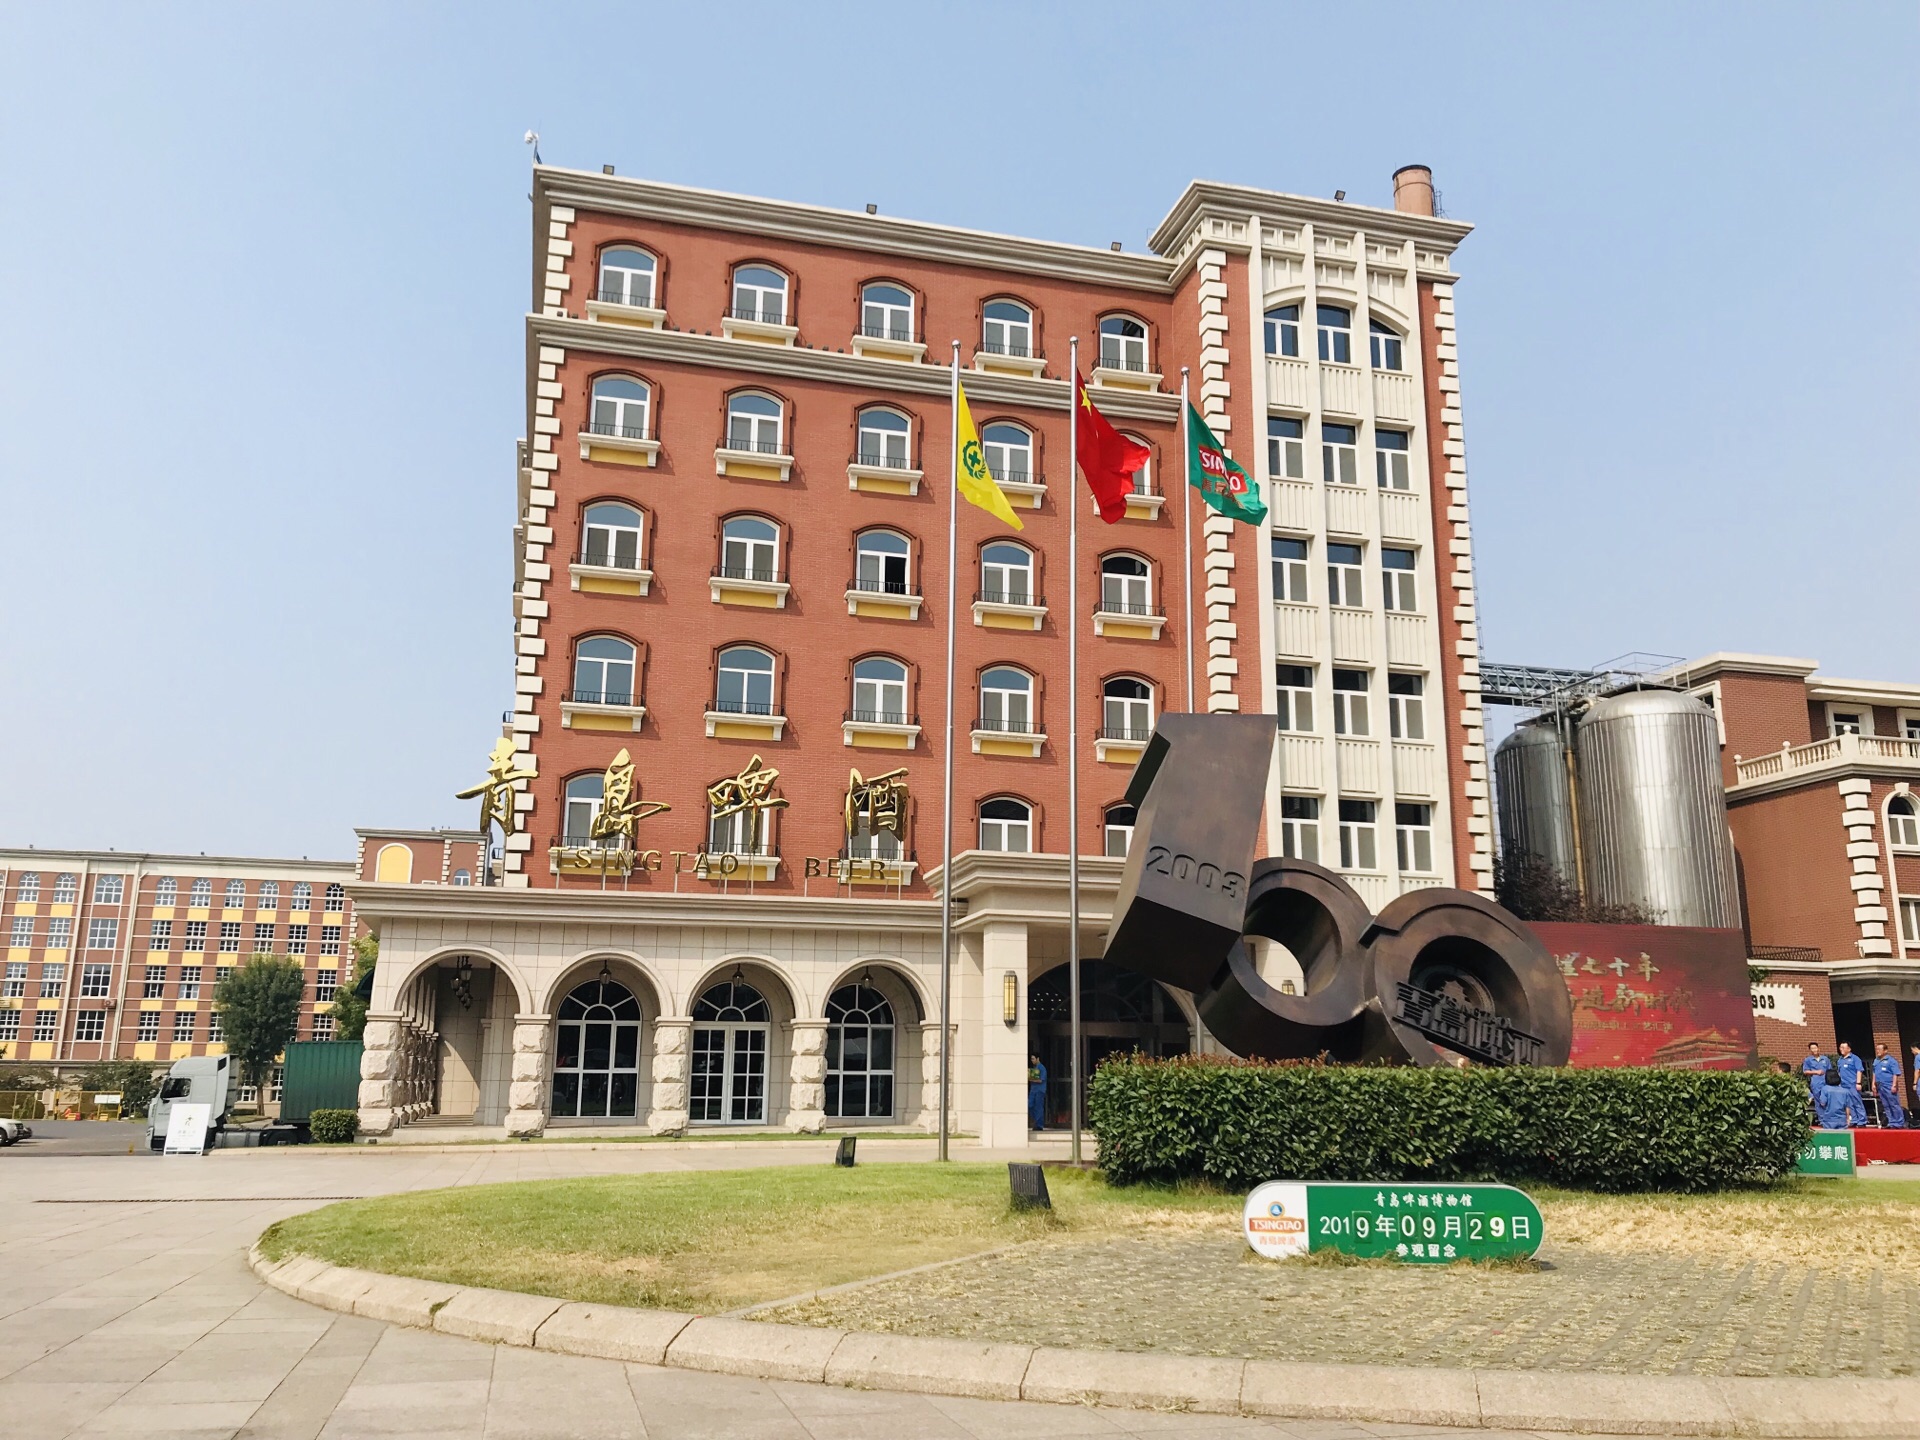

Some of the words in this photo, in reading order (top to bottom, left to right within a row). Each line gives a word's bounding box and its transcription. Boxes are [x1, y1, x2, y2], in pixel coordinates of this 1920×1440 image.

[550, 846, 739, 875] TSINGTAO
[804, 856, 886, 880] BEER
[1146, 845, 1247, 900] 2003
[1795, 1145, 1849, 1160] 勿攀爬
[1252, 1219, 1302, 1231] TSINGTAO
[1319, 1214, 1530, 1240] 2019年09月29日
[1395, 1242, 1457, 1258] 参观留念
